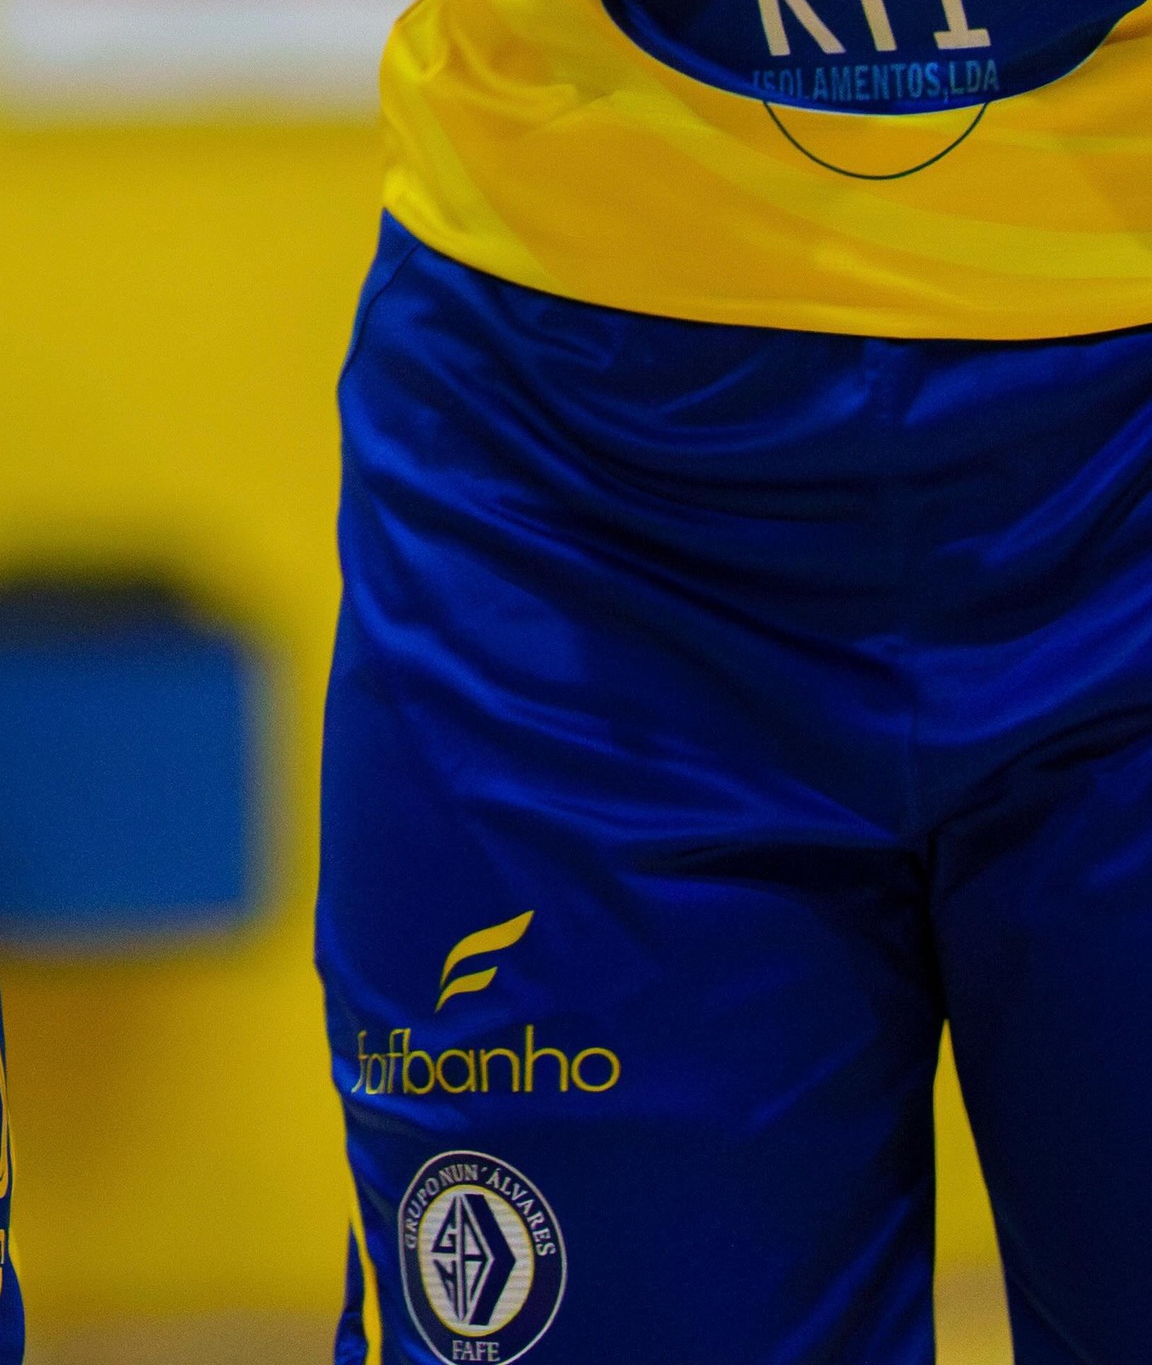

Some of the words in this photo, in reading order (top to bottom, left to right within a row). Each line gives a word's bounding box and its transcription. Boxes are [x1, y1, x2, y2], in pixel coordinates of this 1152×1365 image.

[351, 1024, 621, 1095] fafbanho
[404, 1176, 441, 1250] GRUPO
[452, 1339, 501, 1362] FAFE
